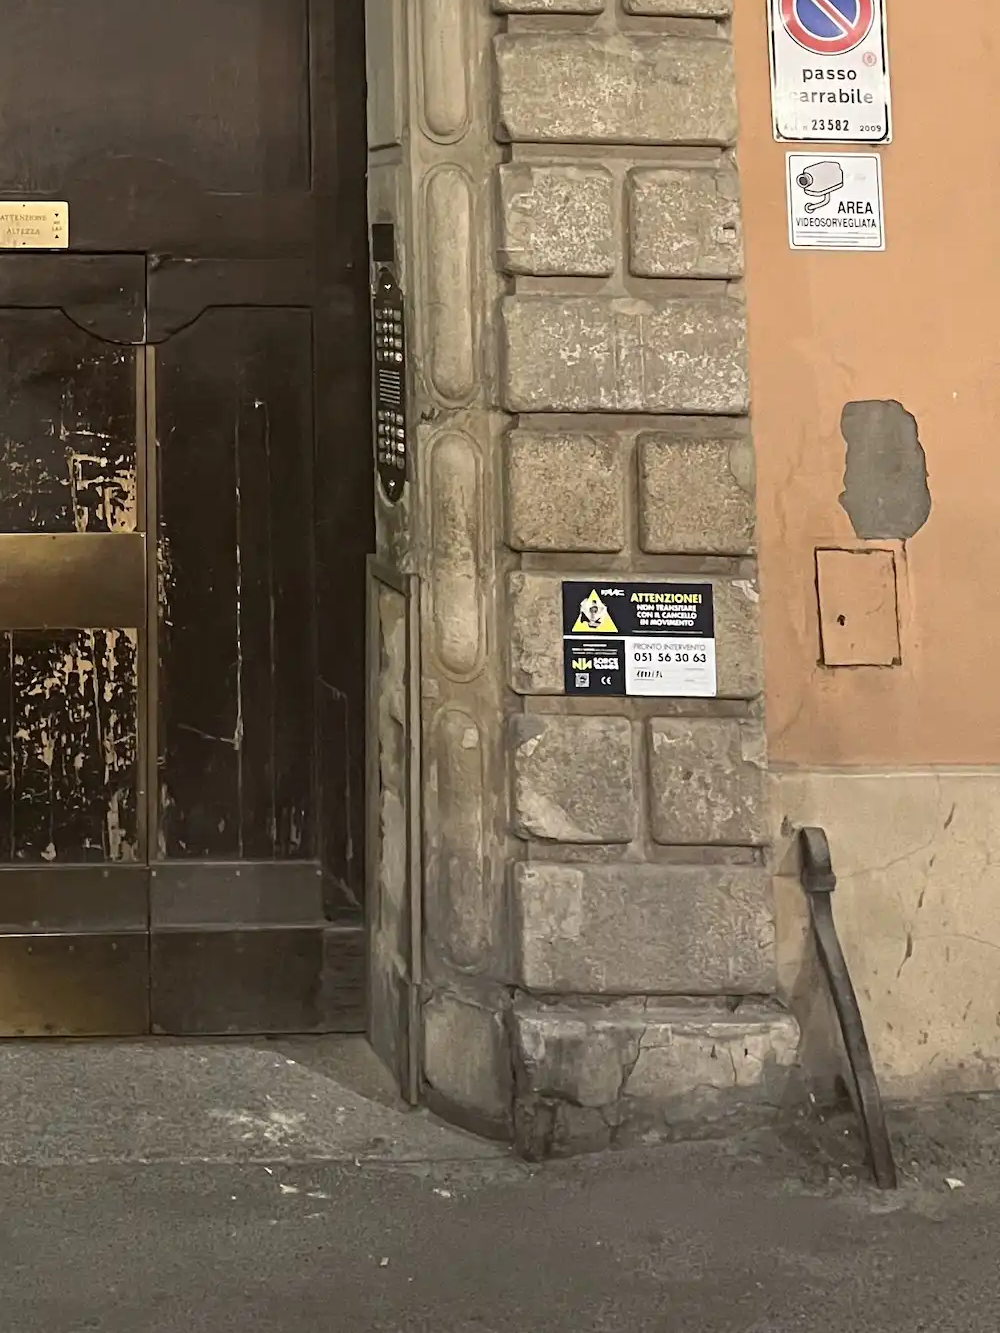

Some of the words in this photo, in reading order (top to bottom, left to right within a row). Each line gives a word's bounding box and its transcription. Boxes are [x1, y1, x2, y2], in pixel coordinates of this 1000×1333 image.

[802, 68, 857, 83] passo
[837, 201, 874, 215] AREA
[0, 214, 48, 222] ATTENZIONE
[796, 217, 877, 228] VIDEOSORVEGLIATA
[6, 226, 41, 236] ALTEZZA
[661, 612, 697, 620] CANCELLO
[633, 643, 662, 651] PRONTO
[663, 643, 706, 651] INTERVENTO
[634, 652, 652, 662] 051
[657, 653, 672, 662] 56
[675, 653, 689, 663] 30
[692, 653, 707, 663] 63
